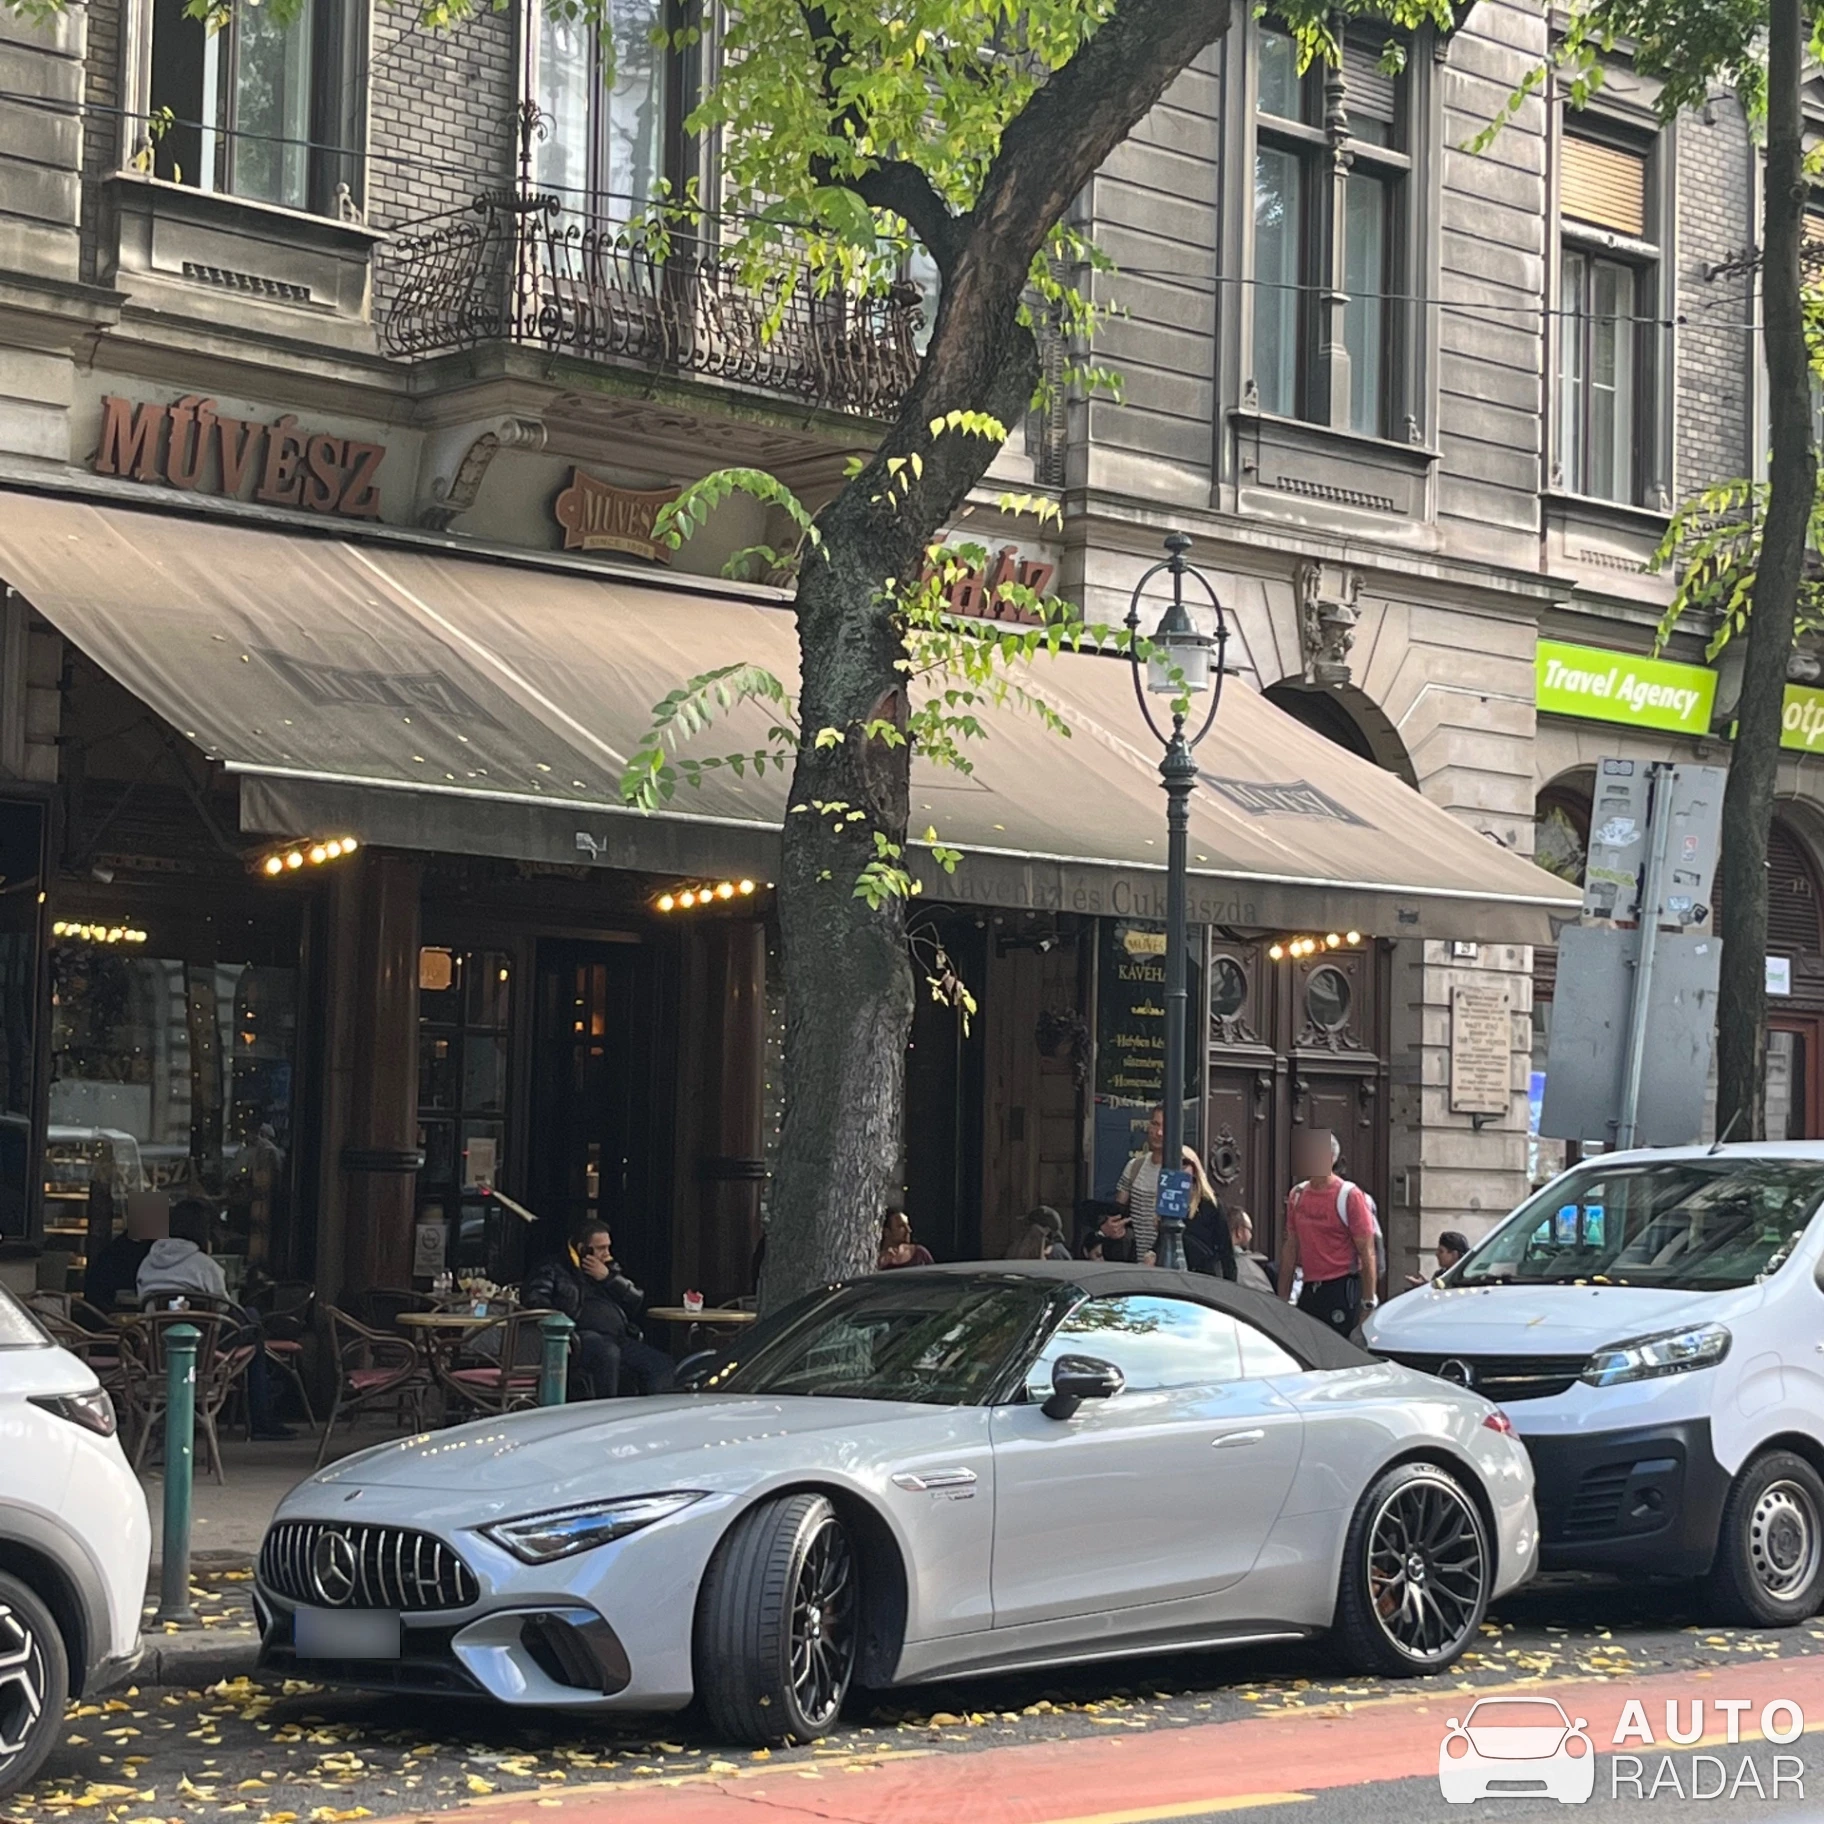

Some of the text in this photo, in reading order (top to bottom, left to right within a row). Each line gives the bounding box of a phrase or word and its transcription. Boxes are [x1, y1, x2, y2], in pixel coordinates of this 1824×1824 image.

[96, 394, 386, 516] MŰVÉSZ
[1543, 659, 1699, 720] Travel Agency
[1782, 698, 1824, 745] otp
[1073, 876, 1100, 911] és
[1111, 880, 1257, 924] Cukászda
